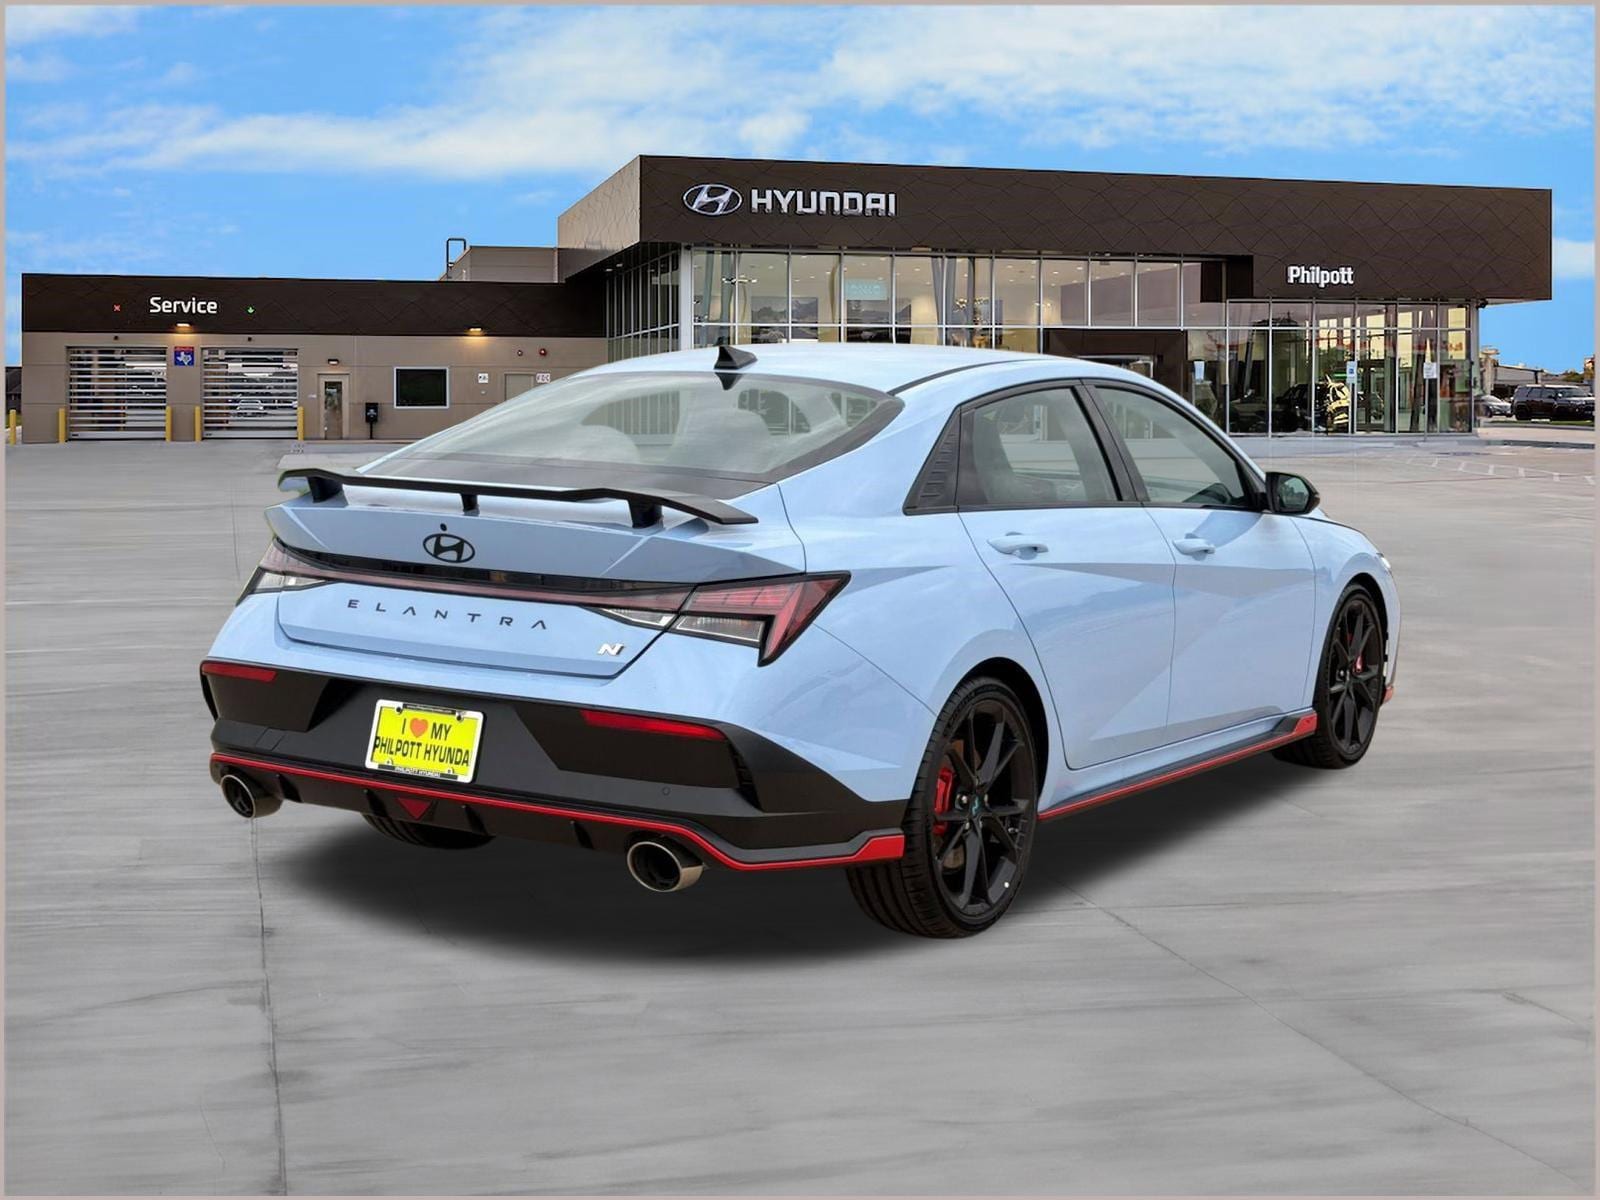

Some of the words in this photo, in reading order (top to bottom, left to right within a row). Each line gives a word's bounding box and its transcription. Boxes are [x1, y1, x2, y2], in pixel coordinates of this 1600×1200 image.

[751, 189, 896, 216] HYUNDAI
[1287, 265, 1354, 288] Philpott
[149, 296, 218, 314] Service
[347, 599, 547, 630] ELANTRA
[401, 718, 407, 735] I
[430, 722, 452, 741] MY
[373, 735, 423, 759] PHILPOTT
[423, 743, 471, 767] HYUNDA
